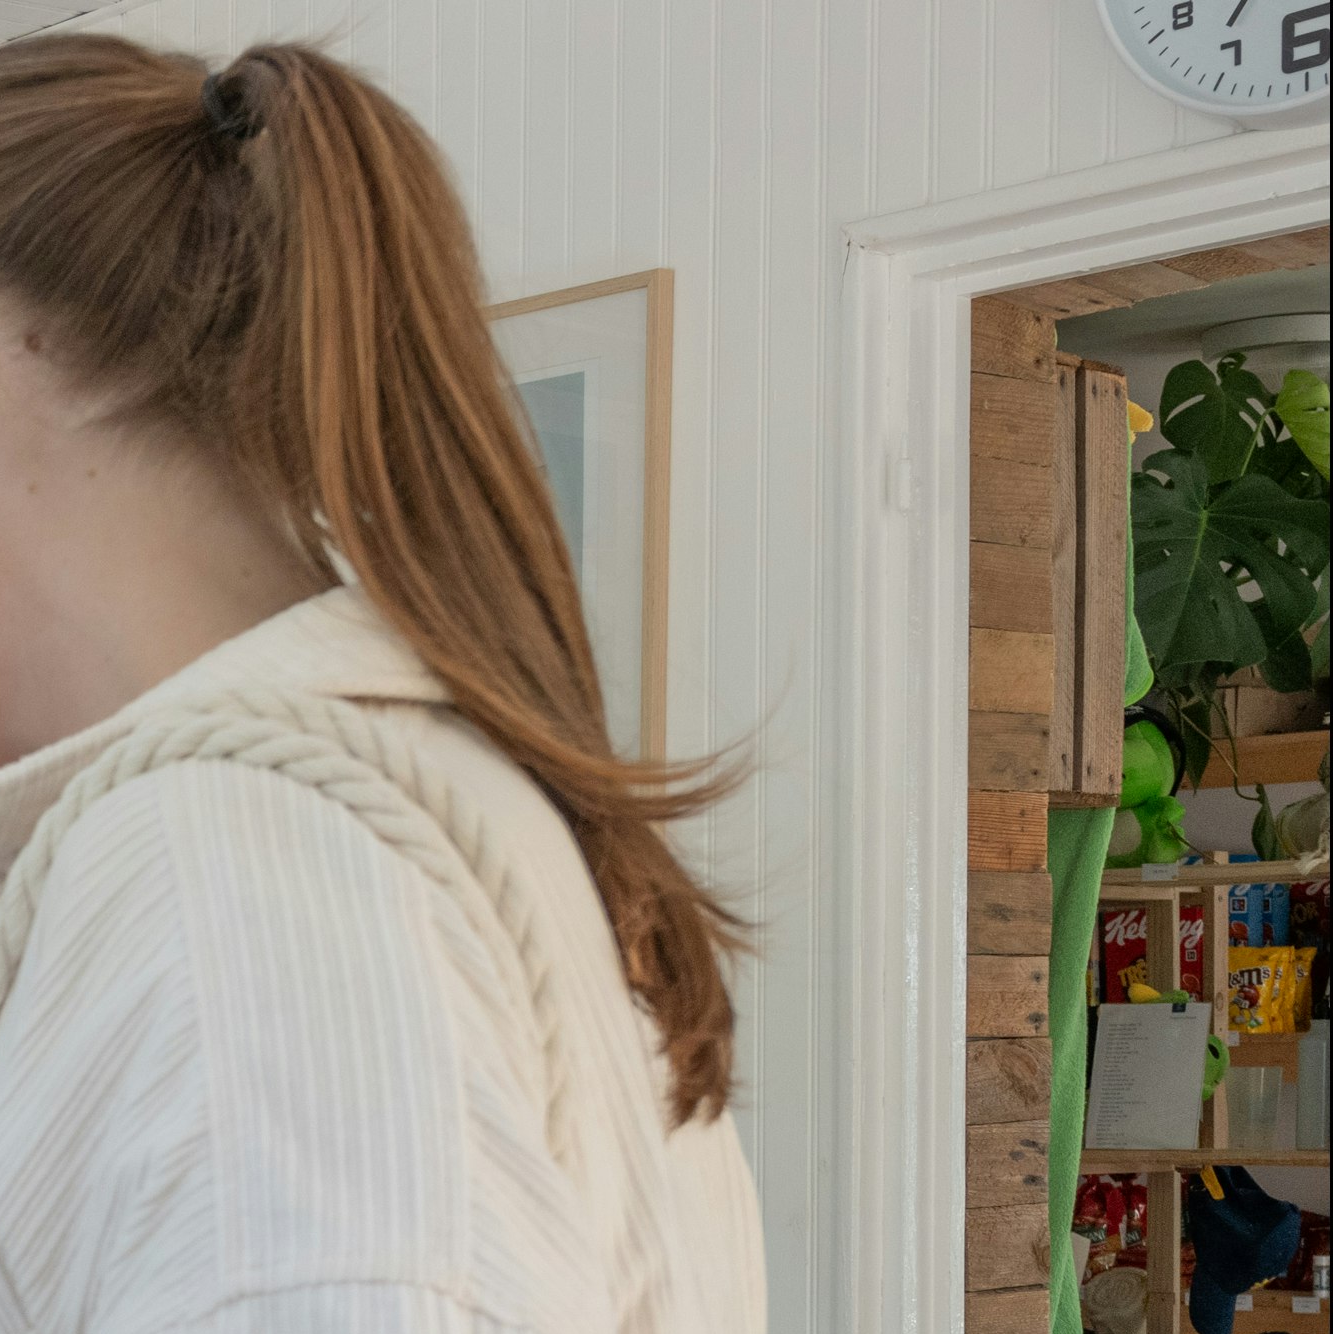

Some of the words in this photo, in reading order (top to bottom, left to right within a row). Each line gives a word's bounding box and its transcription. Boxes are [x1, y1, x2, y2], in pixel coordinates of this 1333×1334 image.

[1172, 0, 1193, 30] 8
[1220, 39, 1241, 66] 7
[1281, 2, 1330, 74] 6
